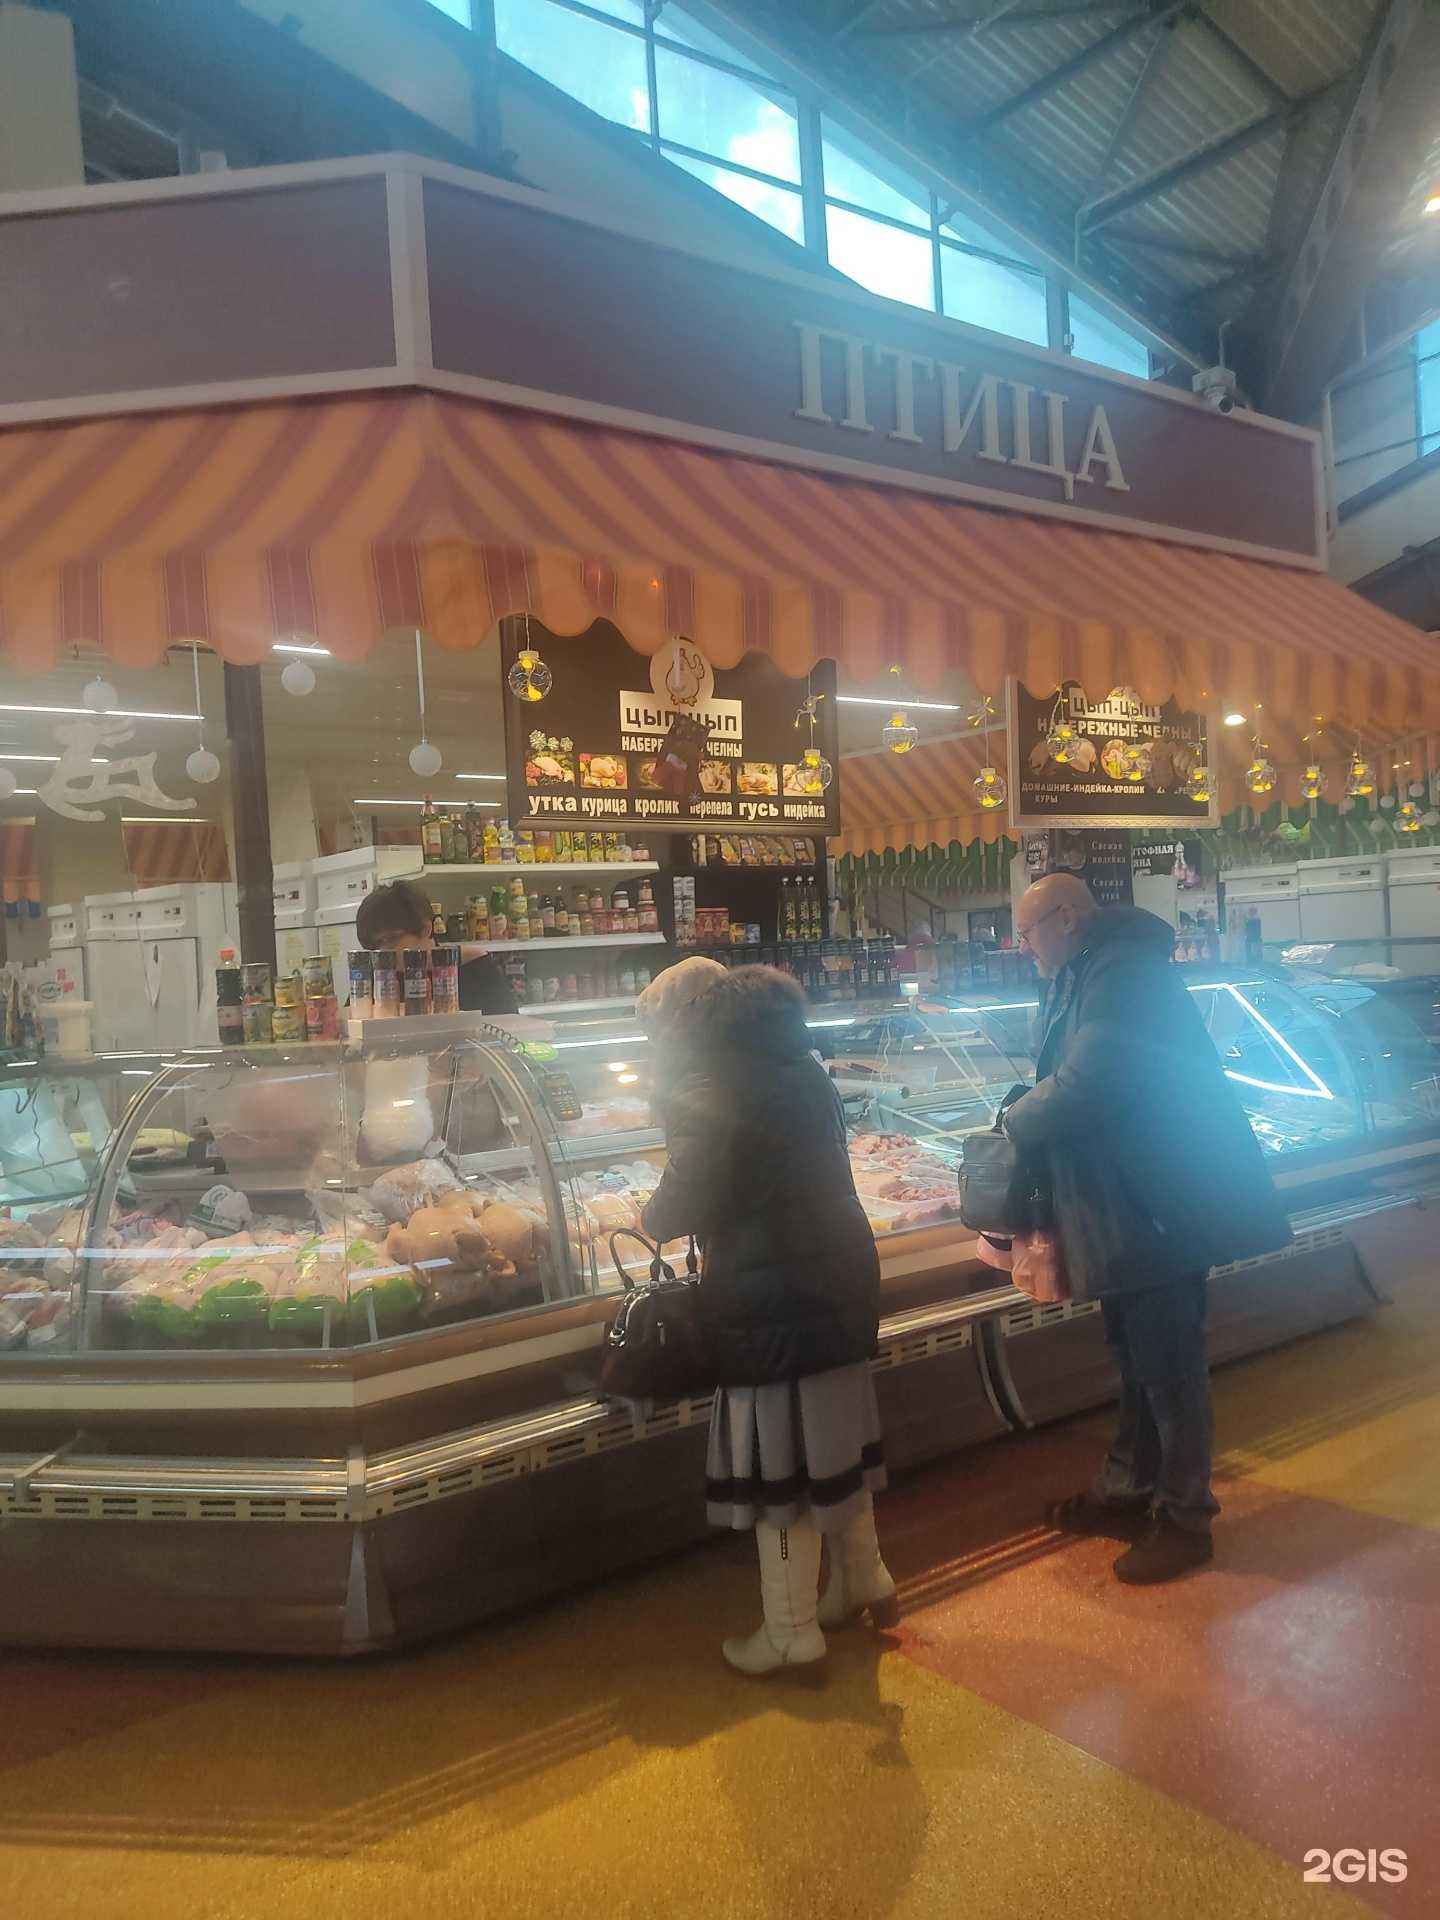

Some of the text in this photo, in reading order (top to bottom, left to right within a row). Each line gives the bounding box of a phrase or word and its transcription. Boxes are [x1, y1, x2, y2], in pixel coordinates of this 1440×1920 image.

[793, 320, 1131, 501] ПТИЦА
[706, 742, 743, 758] ЧЕЛНЫ
[528, 795, 577, 815] утка
[581, 797, 627, 817] курица
[634, 799, 680, 818] кролик
[738, 802, 780, 820] гусь
[783, 800, 826, 820] индейка
